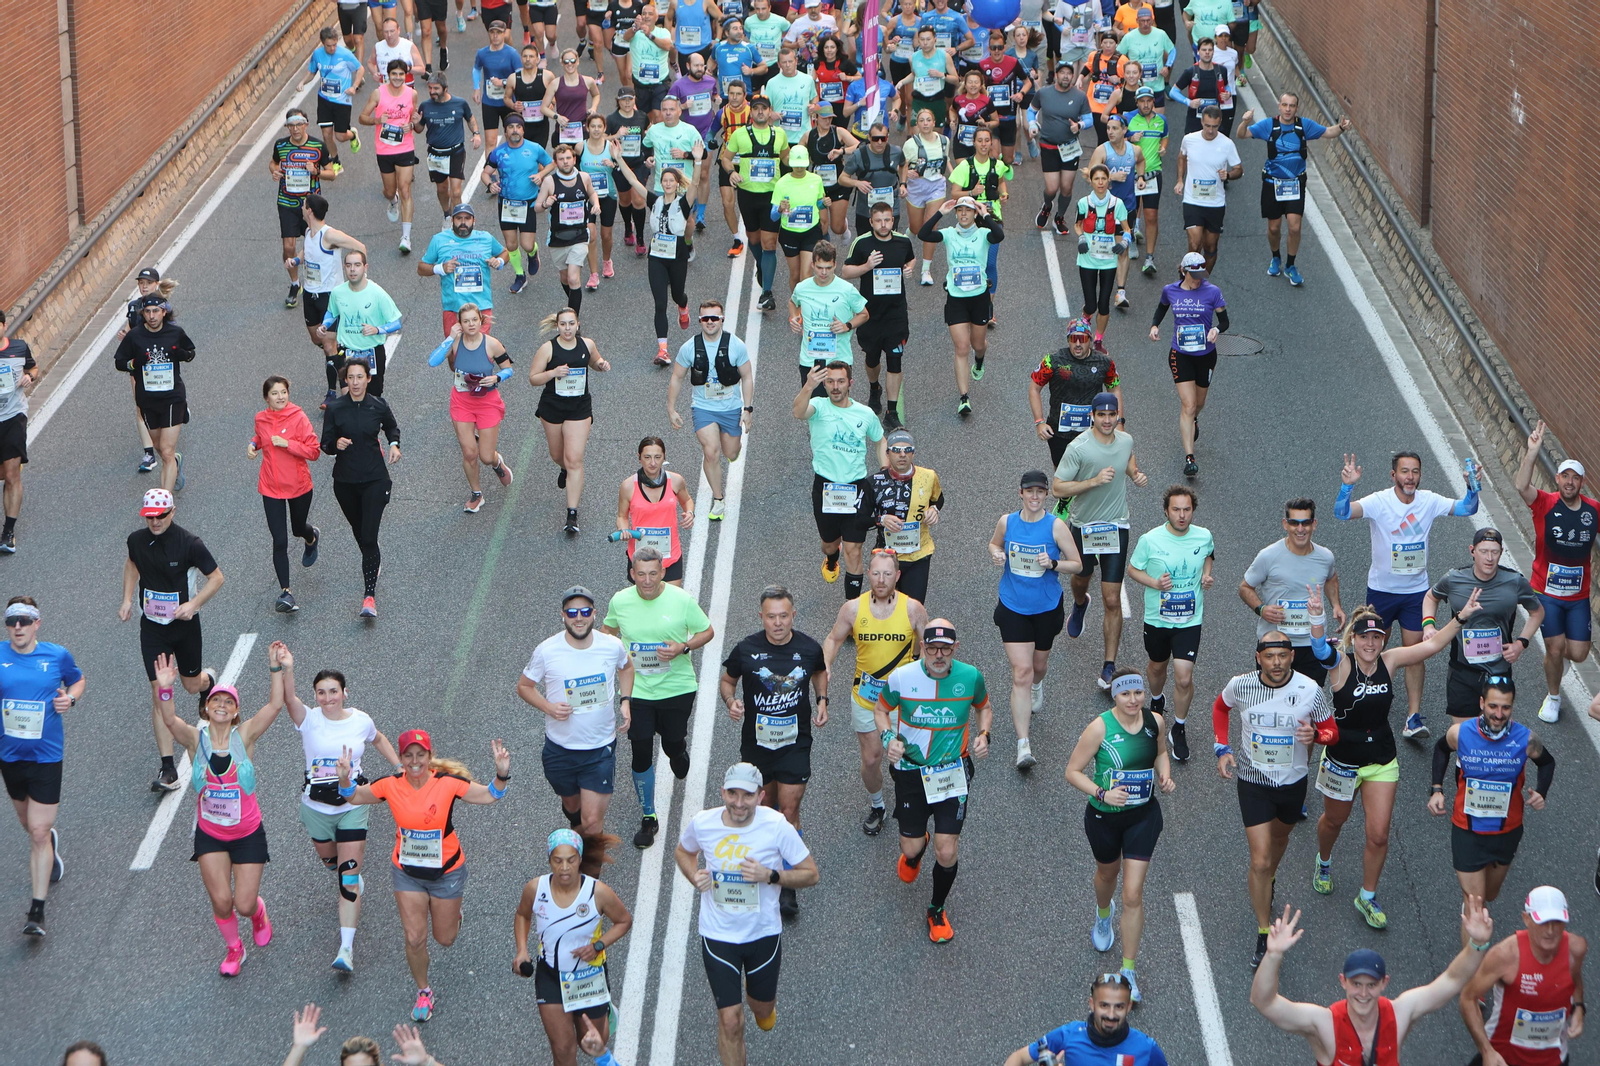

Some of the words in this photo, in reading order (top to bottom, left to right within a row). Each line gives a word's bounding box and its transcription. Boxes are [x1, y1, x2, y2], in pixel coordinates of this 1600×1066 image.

[858, 633, 906, 642] BEDFORD
[579, 675, 602, 685] ZURICH
[870, 679, 886, 687] ZURI
[1365, 683, 1388, 695] asics
[579, 690, 596, 698] 10504
[16, 702, 39, 711] ZURICH
[1470, 748, 1511, 758] FUNDACIÓN
[1461, 755, 1481, 764] JOSEP
[1483, 757, 1521, 765] CARRERAS
[1330, 766, 1352, 777] ZURICH
[1464, 763, 1483, 772] Contra
[1127, 771, 1149, 779] ZURICH
[1482, 782, 1505, 791] ZURICH
[412, 829, 436, 839] ZURICH
[576, 967, 600, 978] ZURICH
[1534, 1013, 1560, 1021] ZURICH
